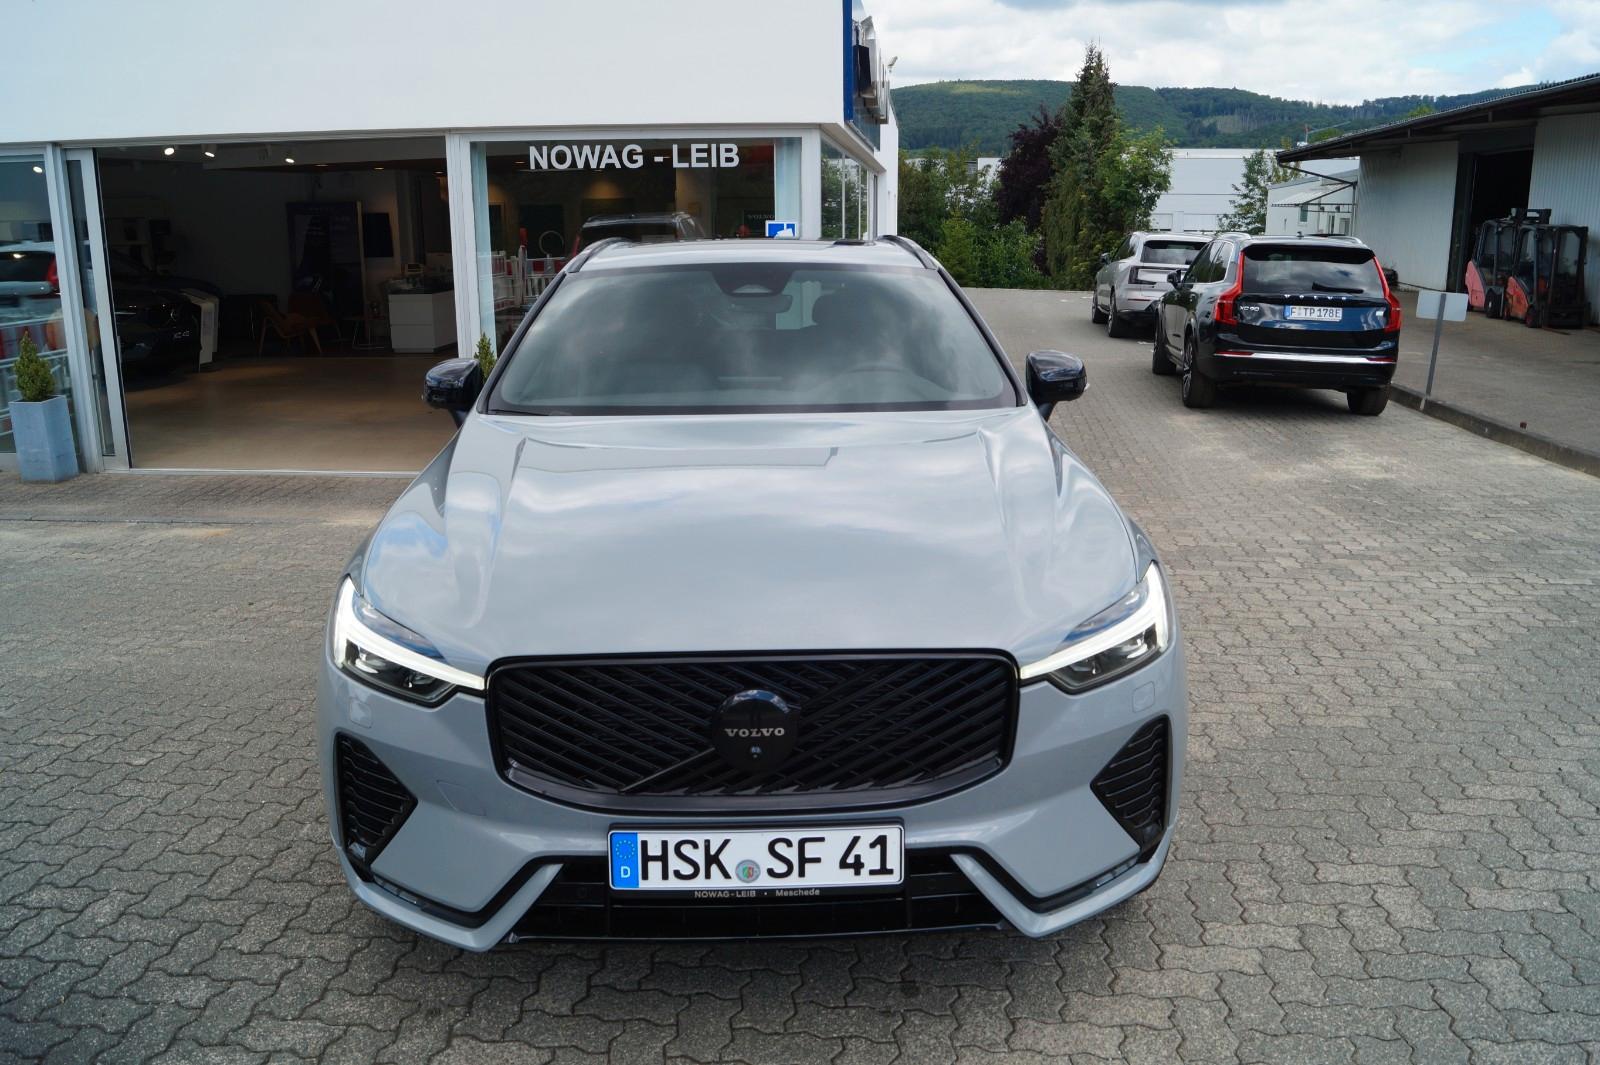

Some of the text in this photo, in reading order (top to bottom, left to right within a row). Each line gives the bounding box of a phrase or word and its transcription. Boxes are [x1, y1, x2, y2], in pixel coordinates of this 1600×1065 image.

[529, 144, 644, 169] NOWAG
[672, 143, 740, 168] LEIB
[1290, 307, 1297, 317] F
[1303, 307, 1316, 317] TP
[724, 727, 785, 738] VOLVO
[640, 834, 894, 881] HSK SF 41
[620, 865, 631, 878] D
[775, 887, 820, 897] Meschede
